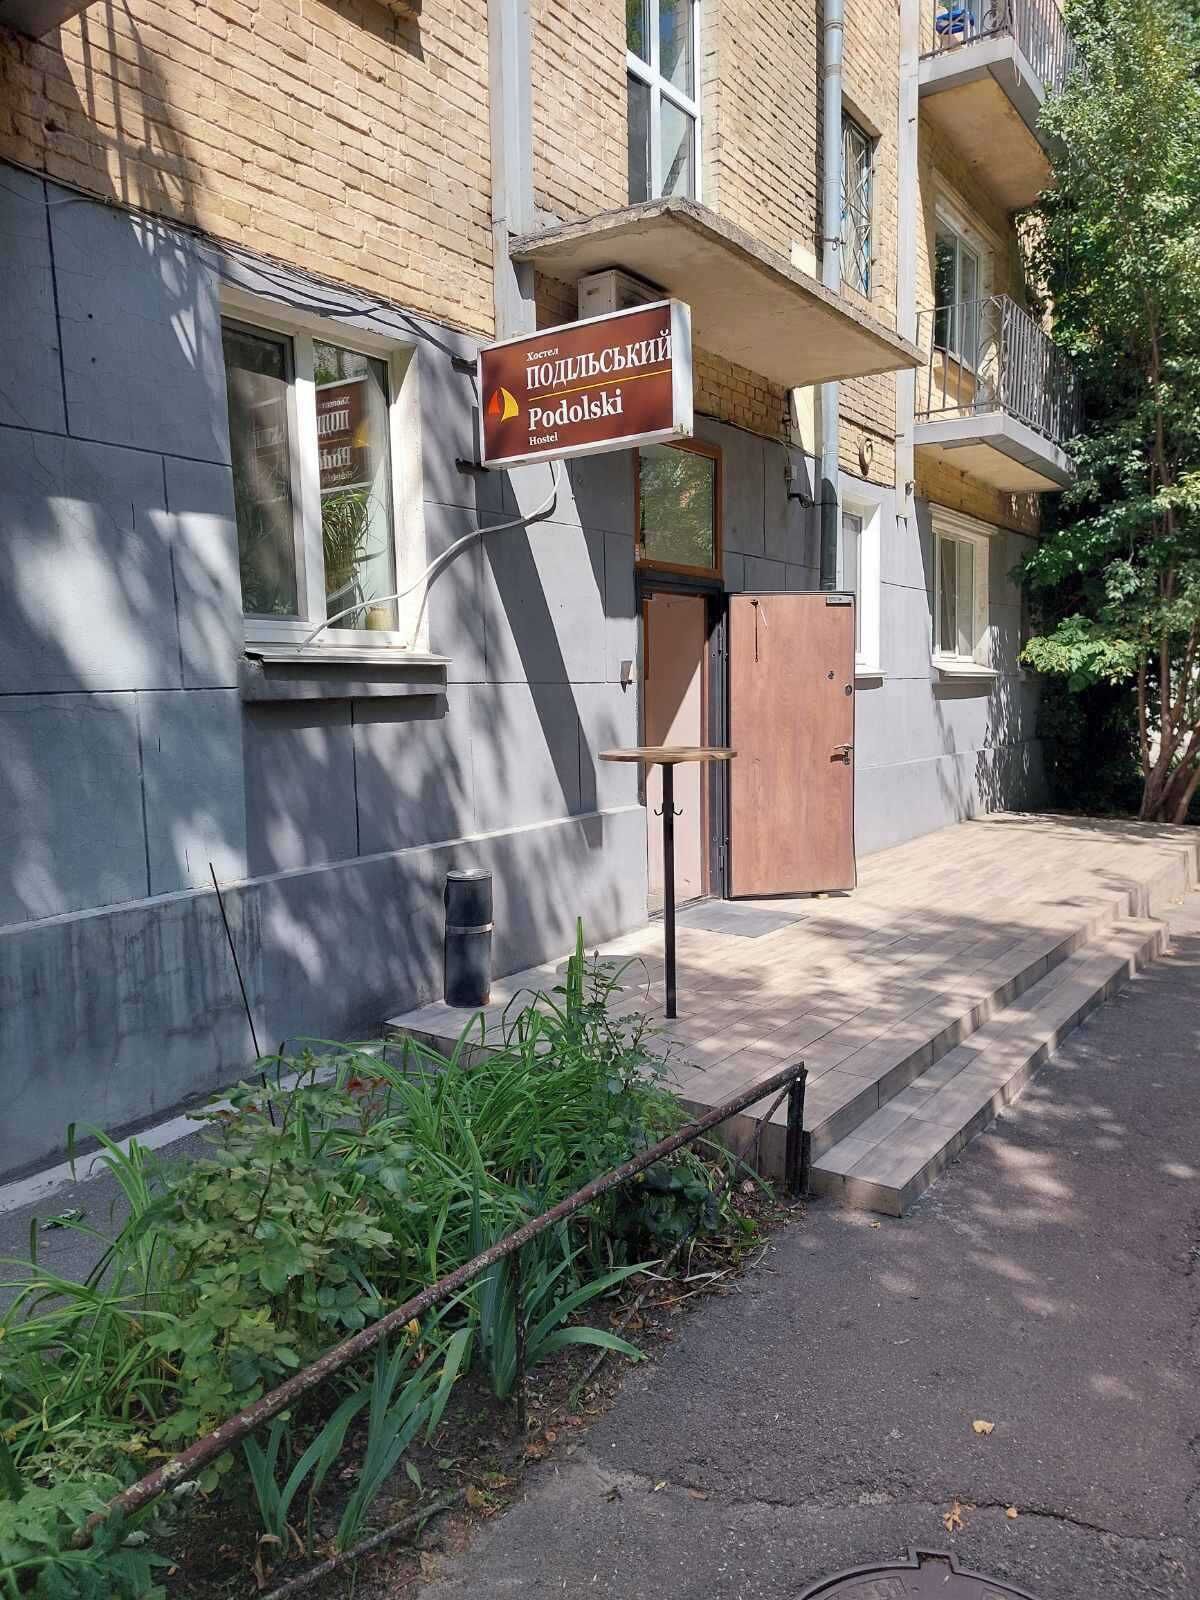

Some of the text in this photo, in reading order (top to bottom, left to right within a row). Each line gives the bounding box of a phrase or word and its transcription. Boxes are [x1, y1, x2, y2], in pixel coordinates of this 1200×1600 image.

[526, 347, 559, 362] Хостел
[526, 328, 673, 390] ПОДІЛЬСЬКИЙ
[528, 388, 624, 431] Podolski
[529, 431, 558, 446] Hostel
